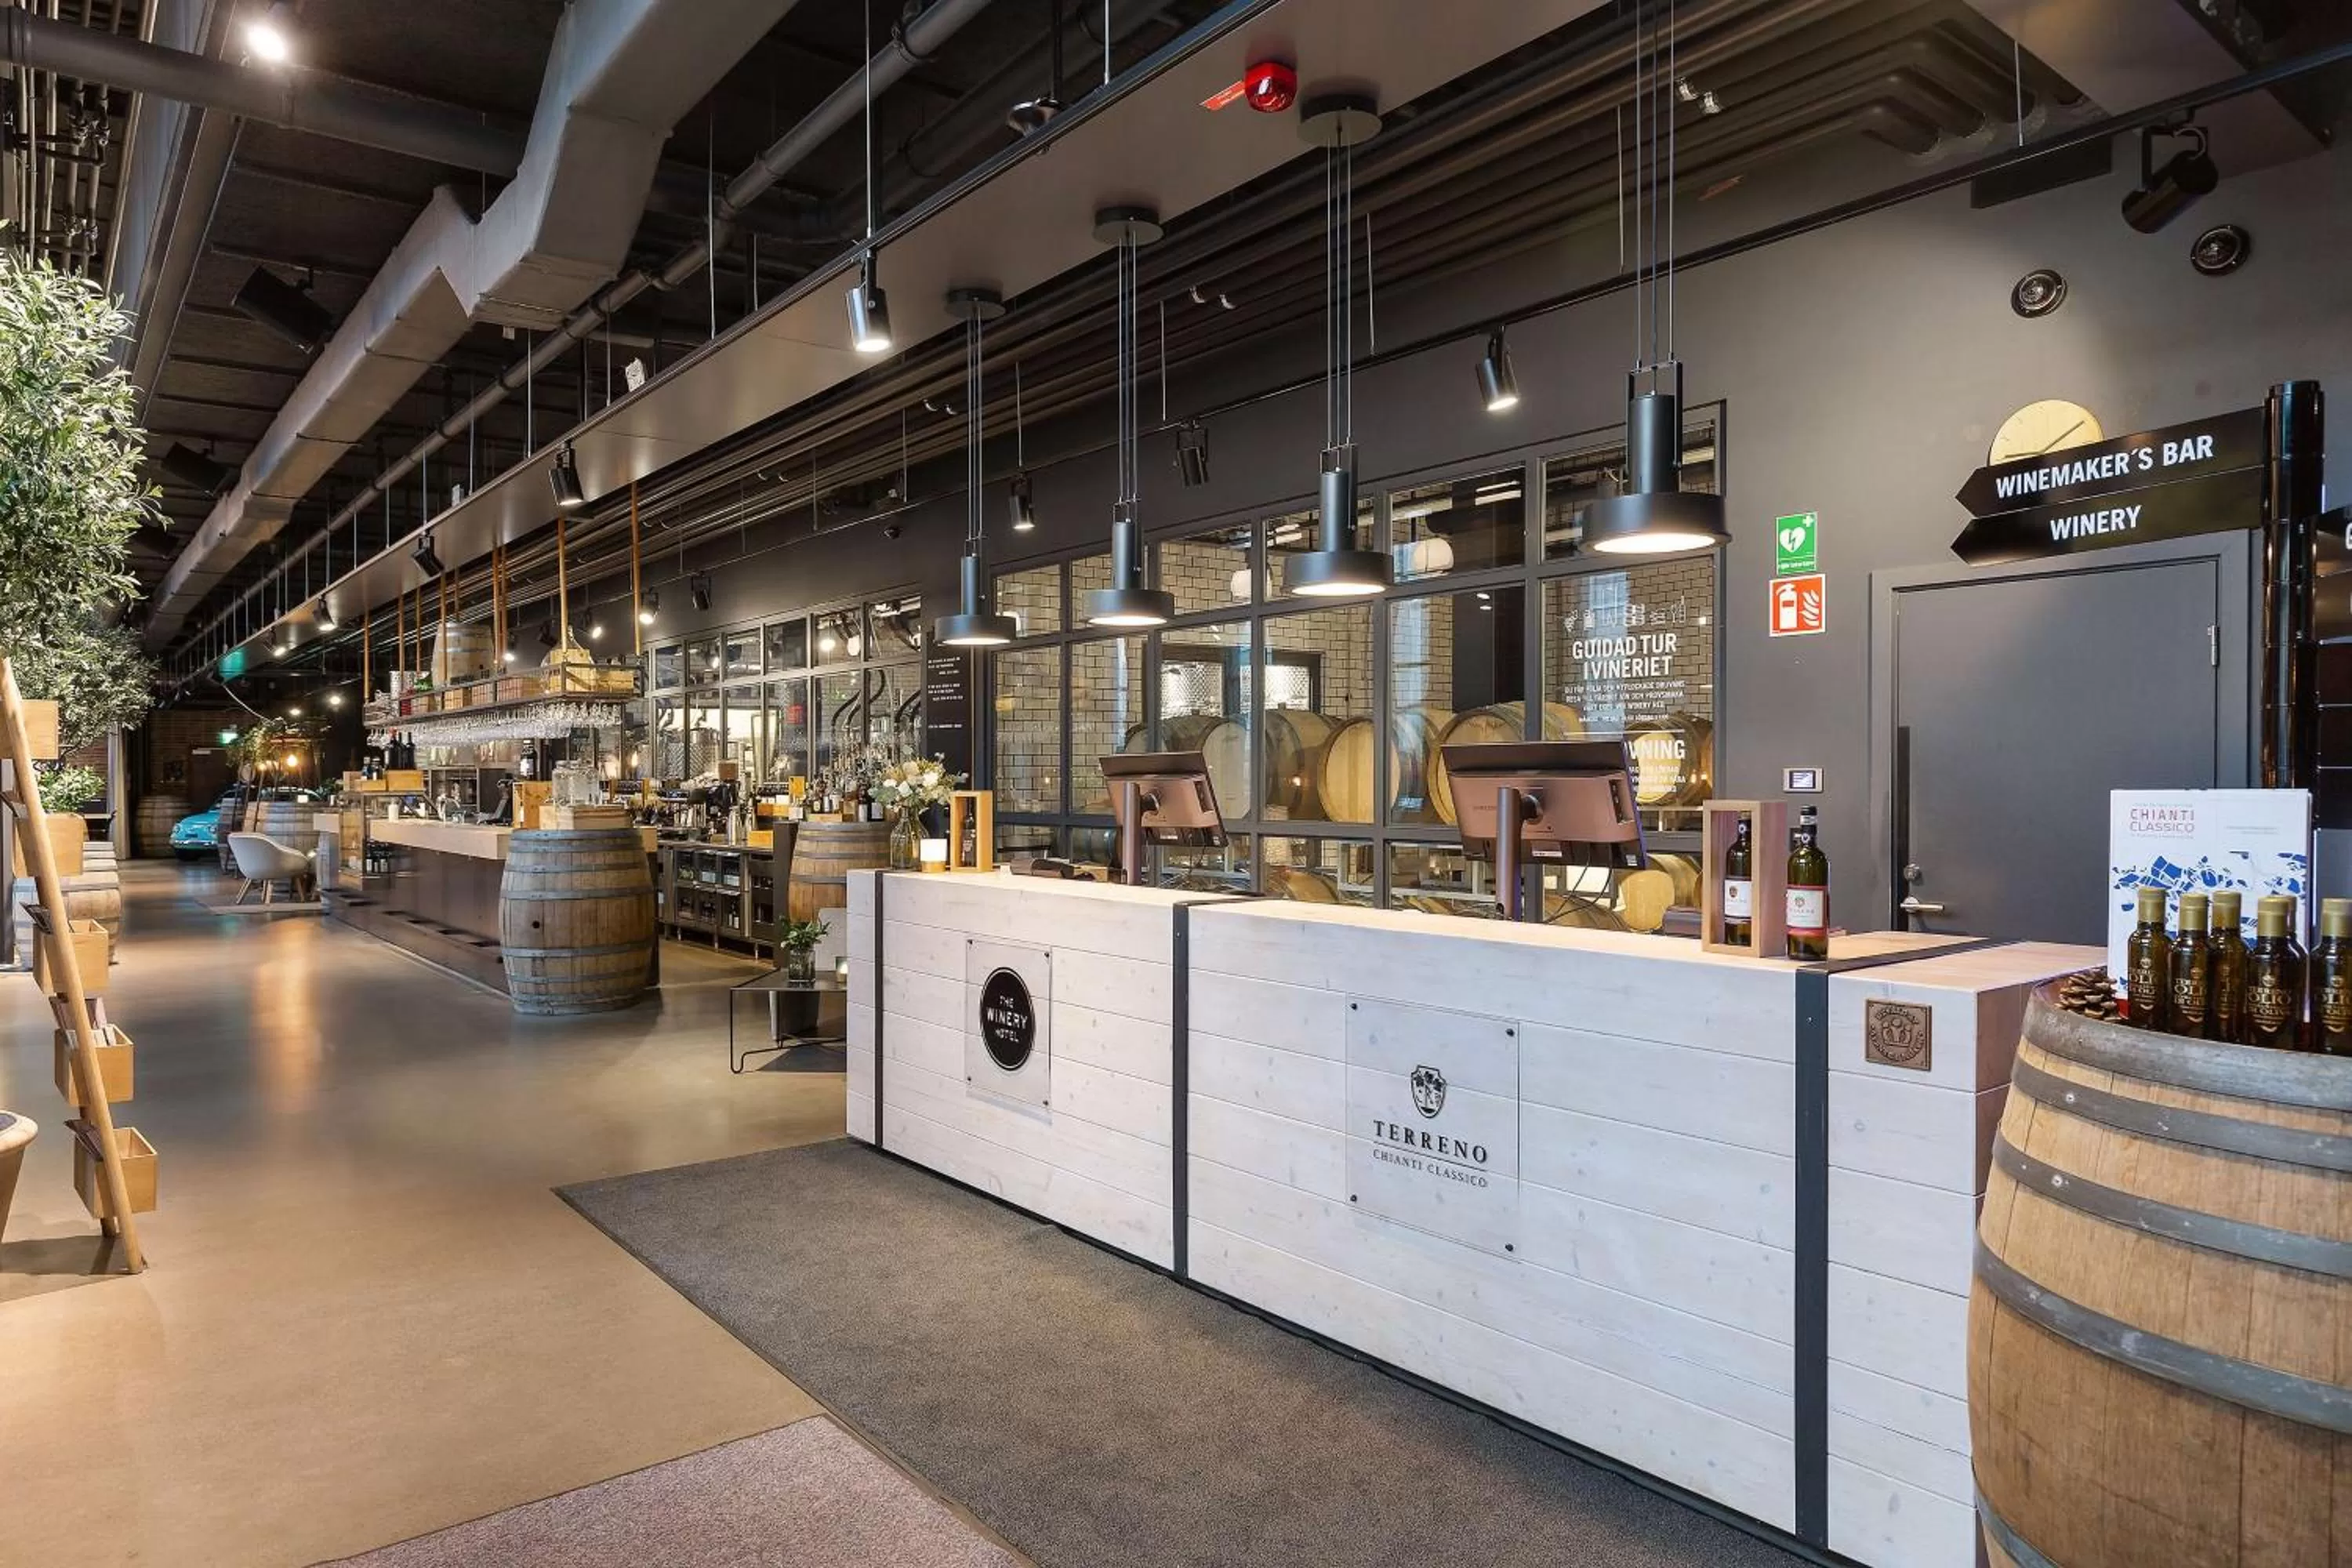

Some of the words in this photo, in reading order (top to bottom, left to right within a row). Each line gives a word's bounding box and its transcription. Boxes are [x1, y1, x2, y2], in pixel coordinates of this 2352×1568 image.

[2162, 434, 2214, 466] BAR
[2049, 505, 2143, 541] WINERY
[1572, 636, 1637, 659] GUIDAD
[1640, 633, 1677, 655] TUR
[1584, 661, 1588, 680] I
[1591, 655, 1672, 680] VINERIET
[2129, 821, 2195, 833] CLASSICO
[2130, 808, 2194, 821] CHIANTI
[1000, 995, 1014, 1009] THE
[986, 1007, 1028, 1029] WINERY
[995, 1028, 1019, 1043] HOTEL
[1374, 1120, 1488, 1163] TERRENO
[1373, 1149, 1422, 1171] CHIANTI
[1427, 1163, 1488, 1188] CLASSICO
